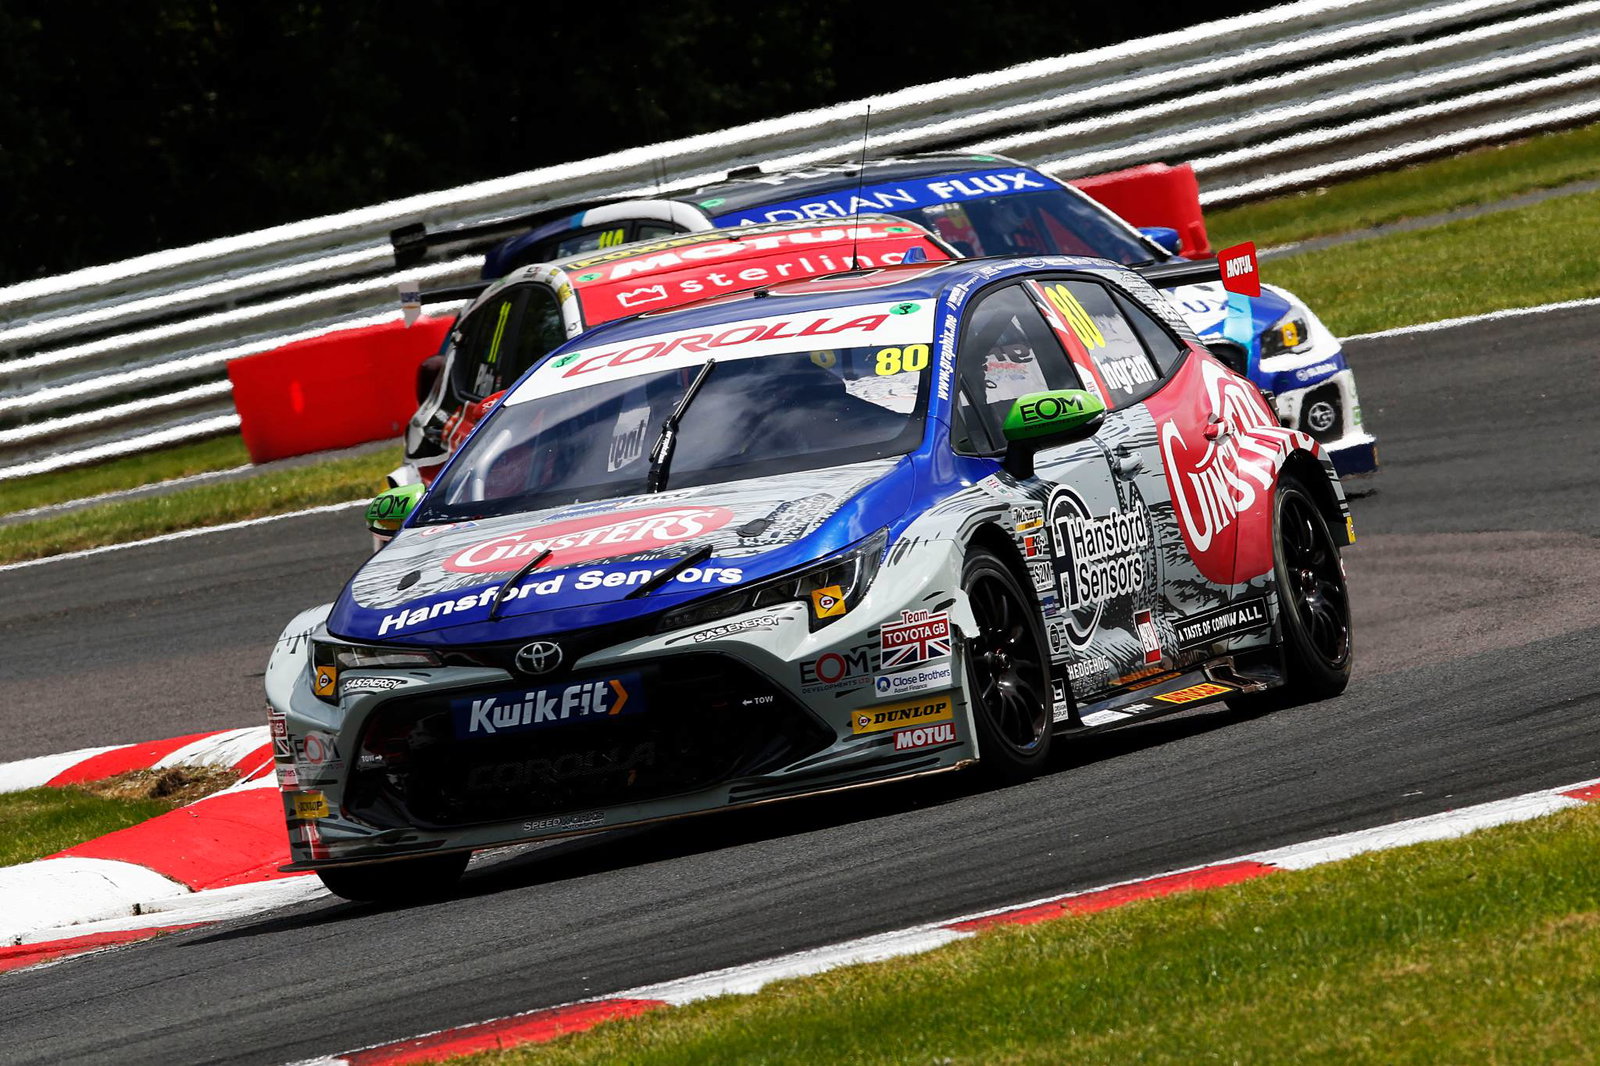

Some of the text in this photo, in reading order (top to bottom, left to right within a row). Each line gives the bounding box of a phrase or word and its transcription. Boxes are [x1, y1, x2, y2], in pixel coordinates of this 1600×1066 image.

[927, 172, 1045, 199] FLUX
[609, 227, 888, 280] MOTUL
[1226, 255, 1253, 278] MOTUL
[1045, 284, 1106, 351] 80
[562, 314, 891, 378] COROLLA
[875, 344, 929, 375] 80
[1093, 354, 1158, 395] Ingram
[1020, 397, 1084, 421] EOM
[371, 495, 409, 519] EOM
[454, 509, 716, 568] GINSTERS
[1070, 503, 1147, 560] Hansford
[1079, 556, 1143, 604] Sensors
[378, 575, 565, 635] Hansford
[902, 611, 928, 625] Team
[886, 622, 946, 645] TOYOTA GB
[1178, 606, 1263, 642] A TASTE OF CORNWALL
[800, 651, 869, 684] EOM
[893, 669, 950, 687] Close Brothers
[1067, 655, 1109, 680] HEDGEHOG
[754, 695, 774, 705] TOW
[802, 681, 858, 694] DEVELOPMENTS
[873, 702, 947, 724] DUNLOP
[896, 724, 954, 749] MOTUL
